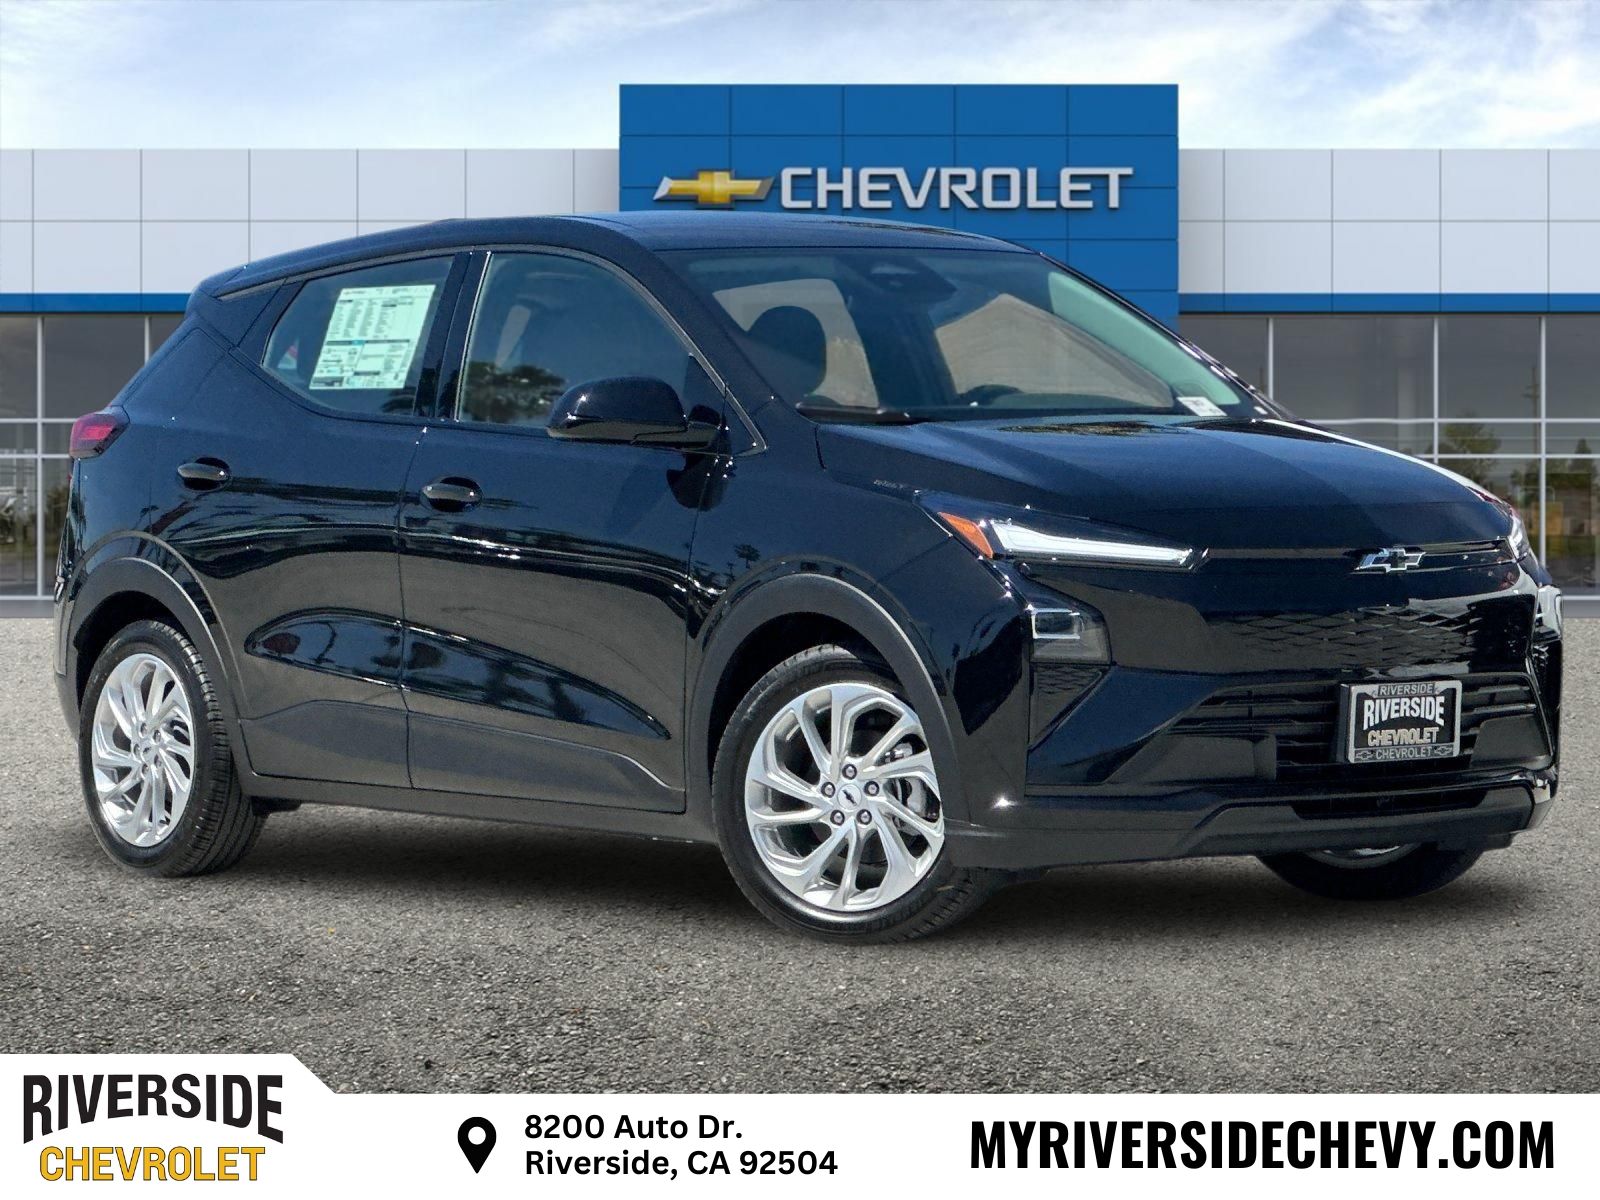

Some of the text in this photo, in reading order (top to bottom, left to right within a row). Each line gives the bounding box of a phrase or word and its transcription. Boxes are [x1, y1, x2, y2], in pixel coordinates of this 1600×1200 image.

[780, 166, 1134, 209] CHEVROLET
[1379, 683, 1434, 695] RIVERSIDE
[1363, 696, 1445, 730] RIVERSIDE
[1367, 727, 1440, 747] CHEVROLET
[1375, 746, 1433, 760] CHEVROLET
